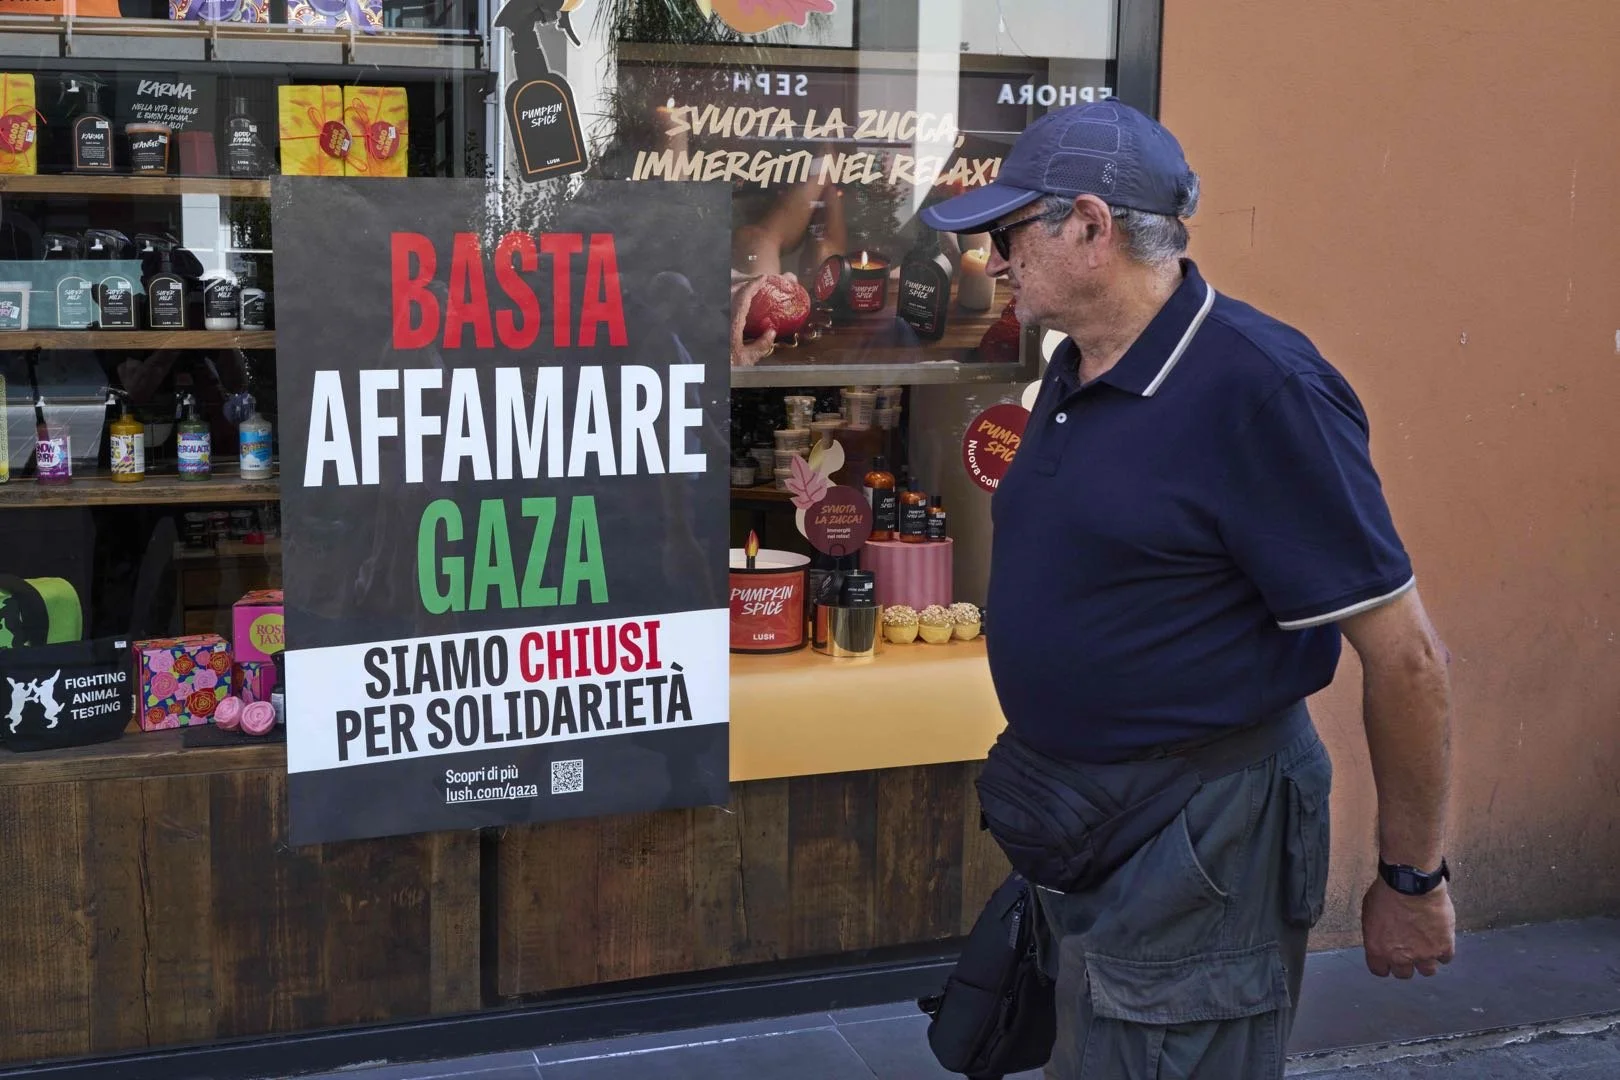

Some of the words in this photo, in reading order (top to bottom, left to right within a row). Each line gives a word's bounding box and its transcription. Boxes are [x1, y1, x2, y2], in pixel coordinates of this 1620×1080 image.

[136, 79, 196, 99] KARMA
[131, 103, 153, 111] NELLA
[154, 104, 168, 112] VITA
[521, 103, 563, 121] PUMPKIN
[530, 113, 557, 128] SPICE
[665, 103, 796, 141] SVUOTA
[802, 107, 848, 141] LA
[853, 108, 966, 150] ZUCCA,
[546, 157, 561, 166] LUSH
[631, 149, 812, 189] IMMERGITI
[817, 151, 884, 186] NEL
[888, 154, 1001, 188] RELAX!
[391, 231, 629, 351] BASTA
[904, 279, 935, 294] PUMPKIN
[908, 289, 928, 299] SPICE
[303, 363, 707, 487] AFFAMARE
[968, 439, 981, 476] Nuova
[821, 504, 857, 514] SVUOTA
[814, 517, 829, 525] LA
[829, 514, 863, 525] ZUCCA!
[417, 496, 610, 615] GAZA
[730, 585, 794, 601] PUMPKIN
[741, 600, 785, 615] SPICE
[753, 632, 775, 640] LUSH
[363, 635, 509, 700] SIAMO
[519, 620, 662, 683] CHIUSI
[65, 671, 127, 690] FIGHTING
[72, 687, 120, 704] ANIMAL
[70, 701, 121, 720] TESTING
[336, 704, 419, 761] PER
[427, 661, 693, 749] SOLIDARIETÀ
[446, 767, 485, 785] Scopri
[487, 766, 498, 781] di
[500, 765, 519, 782] più
[446, 783, 538, 804] lush.com/gaza
